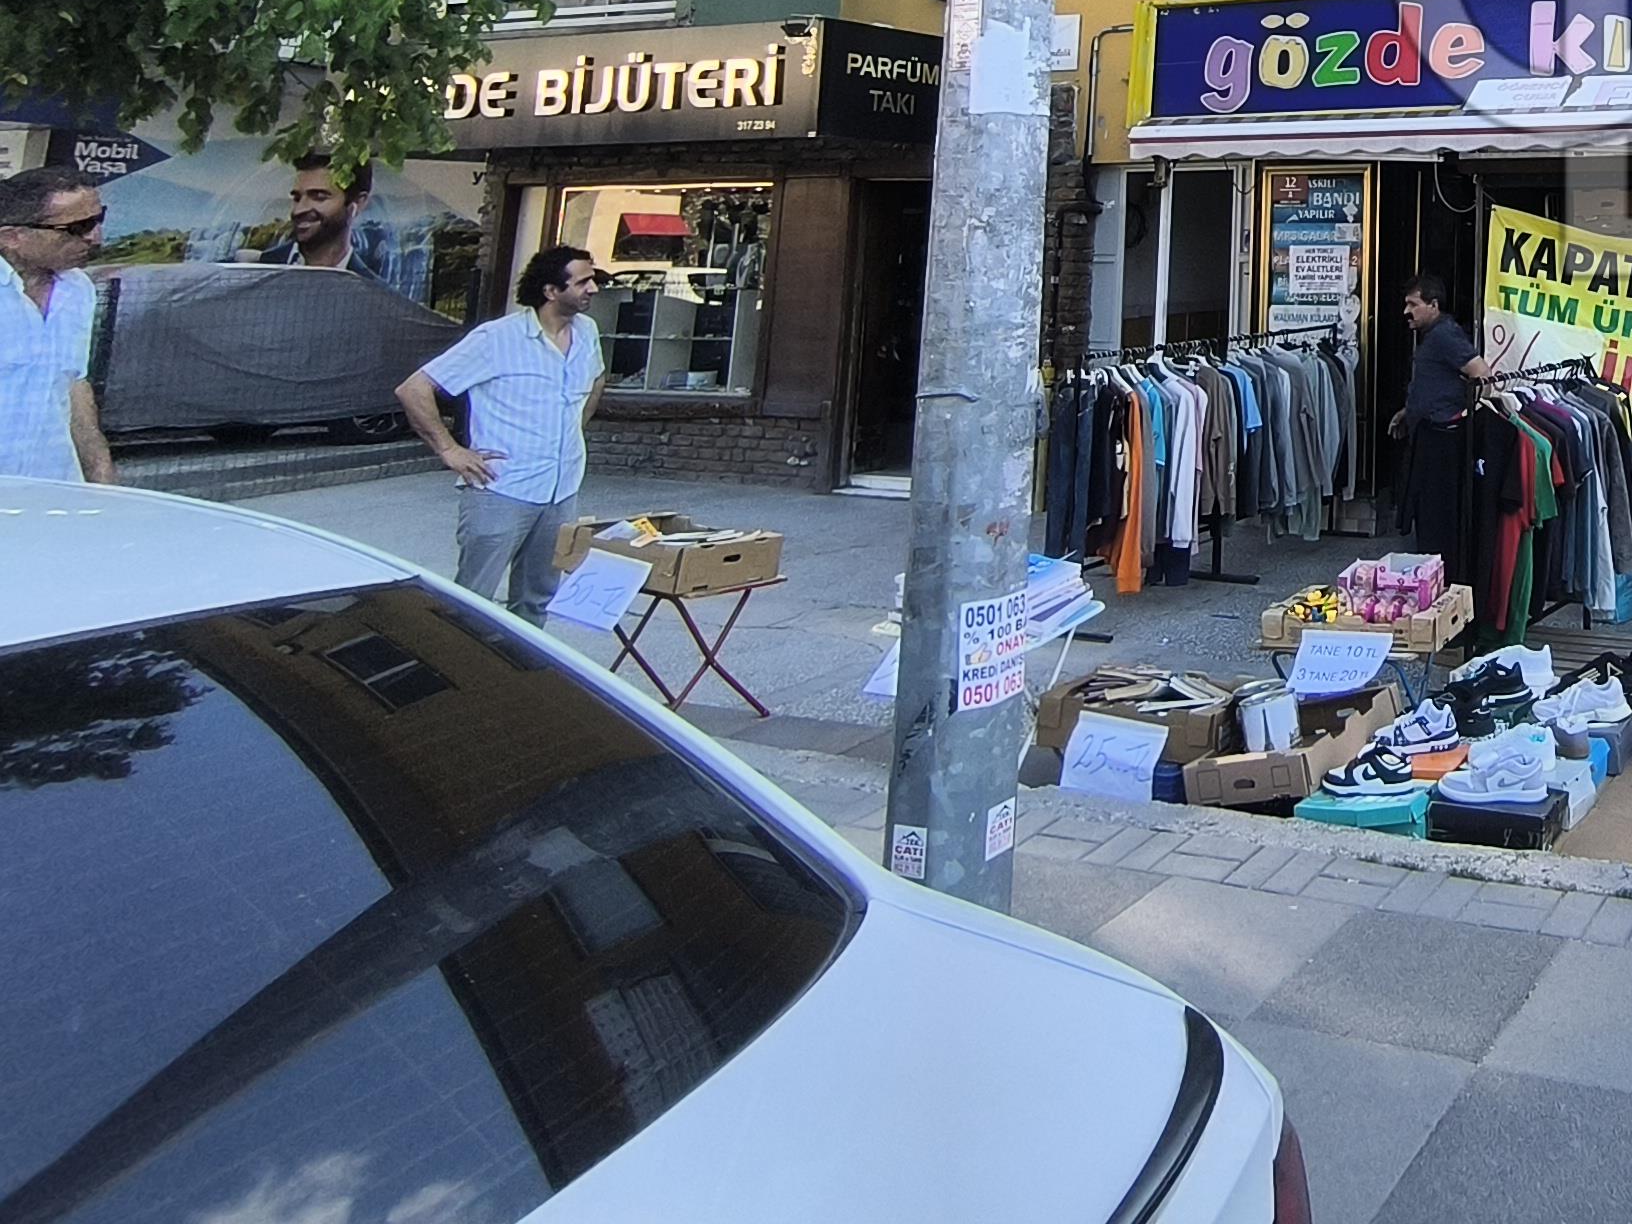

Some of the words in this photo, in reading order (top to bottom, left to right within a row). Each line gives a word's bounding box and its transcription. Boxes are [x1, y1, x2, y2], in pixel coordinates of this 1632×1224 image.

[1200, 0, 1486, 113] gözde
[847, 51, 939, 87] PARFÜM
[534, 43, 783, 117] BİJÜTERİ
[869, 89, 916, 116] TAKI
[74, 142, 139, 160] Mobil
[75, 157, 128, 177] Yaşa
[1285, 177, 1297, 188] 12
[1298, 209, 1335, 219] YAPILIR
[1295, 265, 1306, 273] EV
[1306, 264, 1343, 273] ALETLERİ
[1296, 254, 1343, 264] ELEKTRİKLİ
[1498, 284, 1580, 325] TÜM
[965, 602, 1002, 629] 0501
[988, 624, 1012, 641] 100
[996, 634, 1028, 657] ONAY
[1309, 645, 1342, 657] TANE
[1346, 644, 1364, 657] 10
[1366, 647, 1379, 658] TL
[1296, 668, 1307, 681] 3
[1309, 670, 1338, 682] TANE
[1339, 668, 1358, 681] 20
[962, 681, 1000, 707] 0501
[1003, 671, 1023, 695] 063
